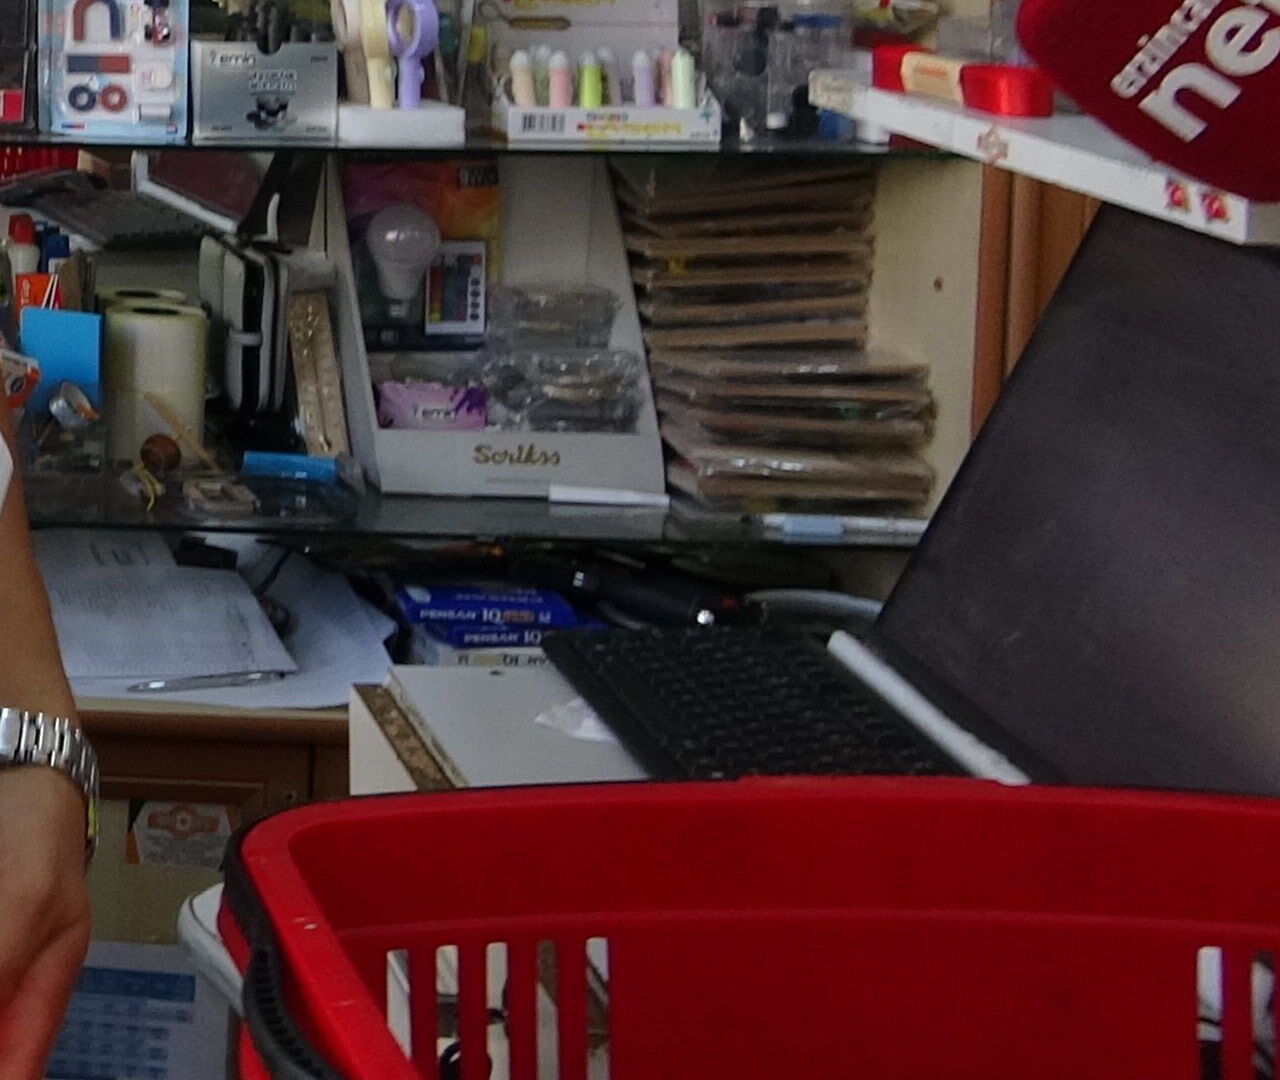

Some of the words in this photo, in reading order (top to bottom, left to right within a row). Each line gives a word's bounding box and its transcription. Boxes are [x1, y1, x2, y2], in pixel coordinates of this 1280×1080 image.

[473, 442, 562, 466] Scrikss
[420, 608, 476, 620] PENSAN
[463, 632, 519, 645] PENSAN
